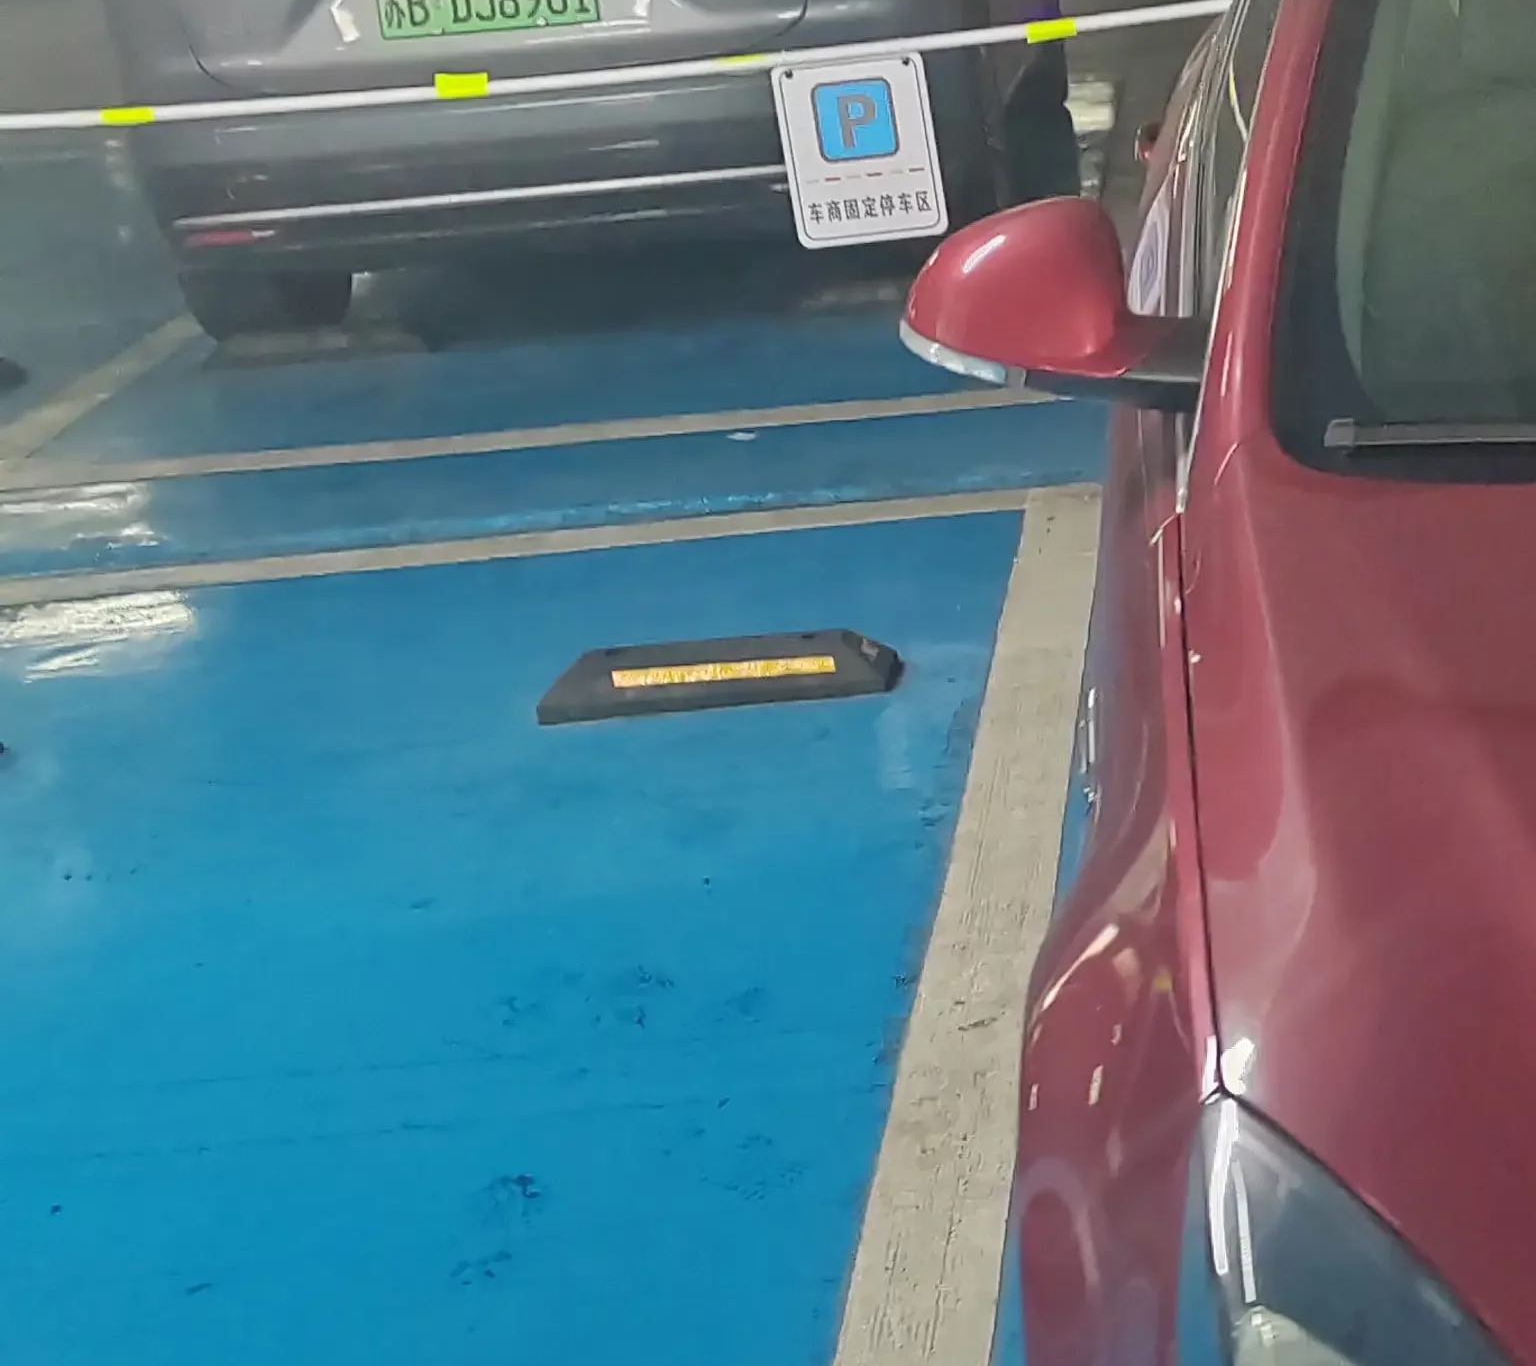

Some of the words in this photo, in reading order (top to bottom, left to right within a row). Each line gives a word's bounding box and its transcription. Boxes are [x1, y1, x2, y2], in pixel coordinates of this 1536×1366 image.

[836, 94, 876, 149] P
[807, 190, 933, 225] 车商固定停车区
